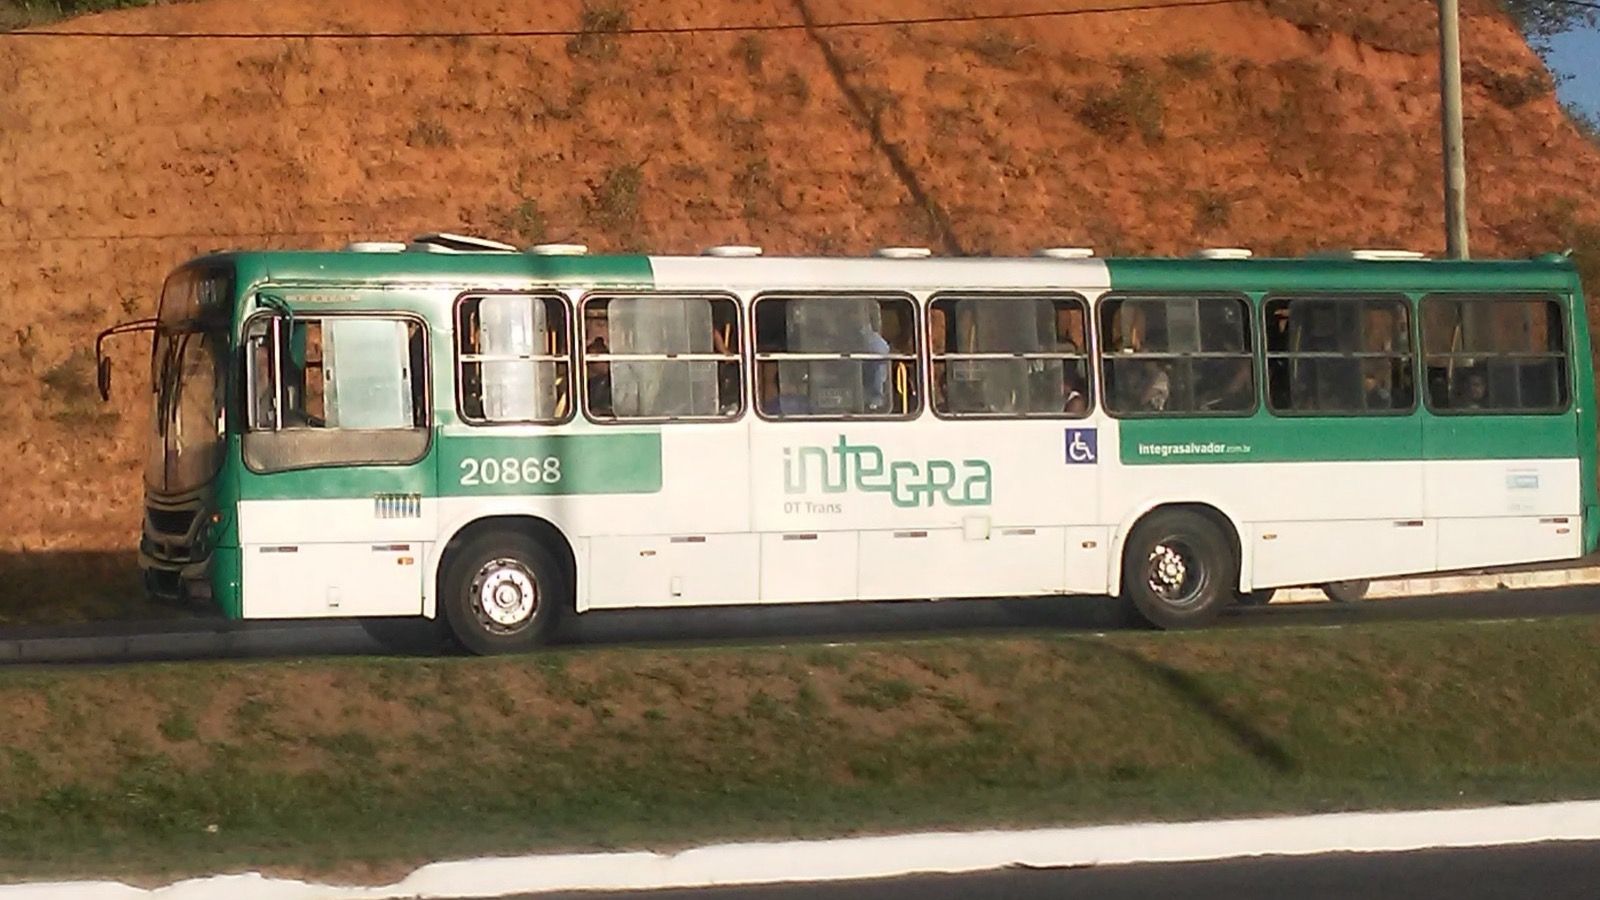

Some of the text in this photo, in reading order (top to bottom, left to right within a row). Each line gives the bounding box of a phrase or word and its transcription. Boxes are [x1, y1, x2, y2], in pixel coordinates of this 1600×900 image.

[459, 457, 562, 485] 20868
[783, 501, 842, 514] OT Trans
